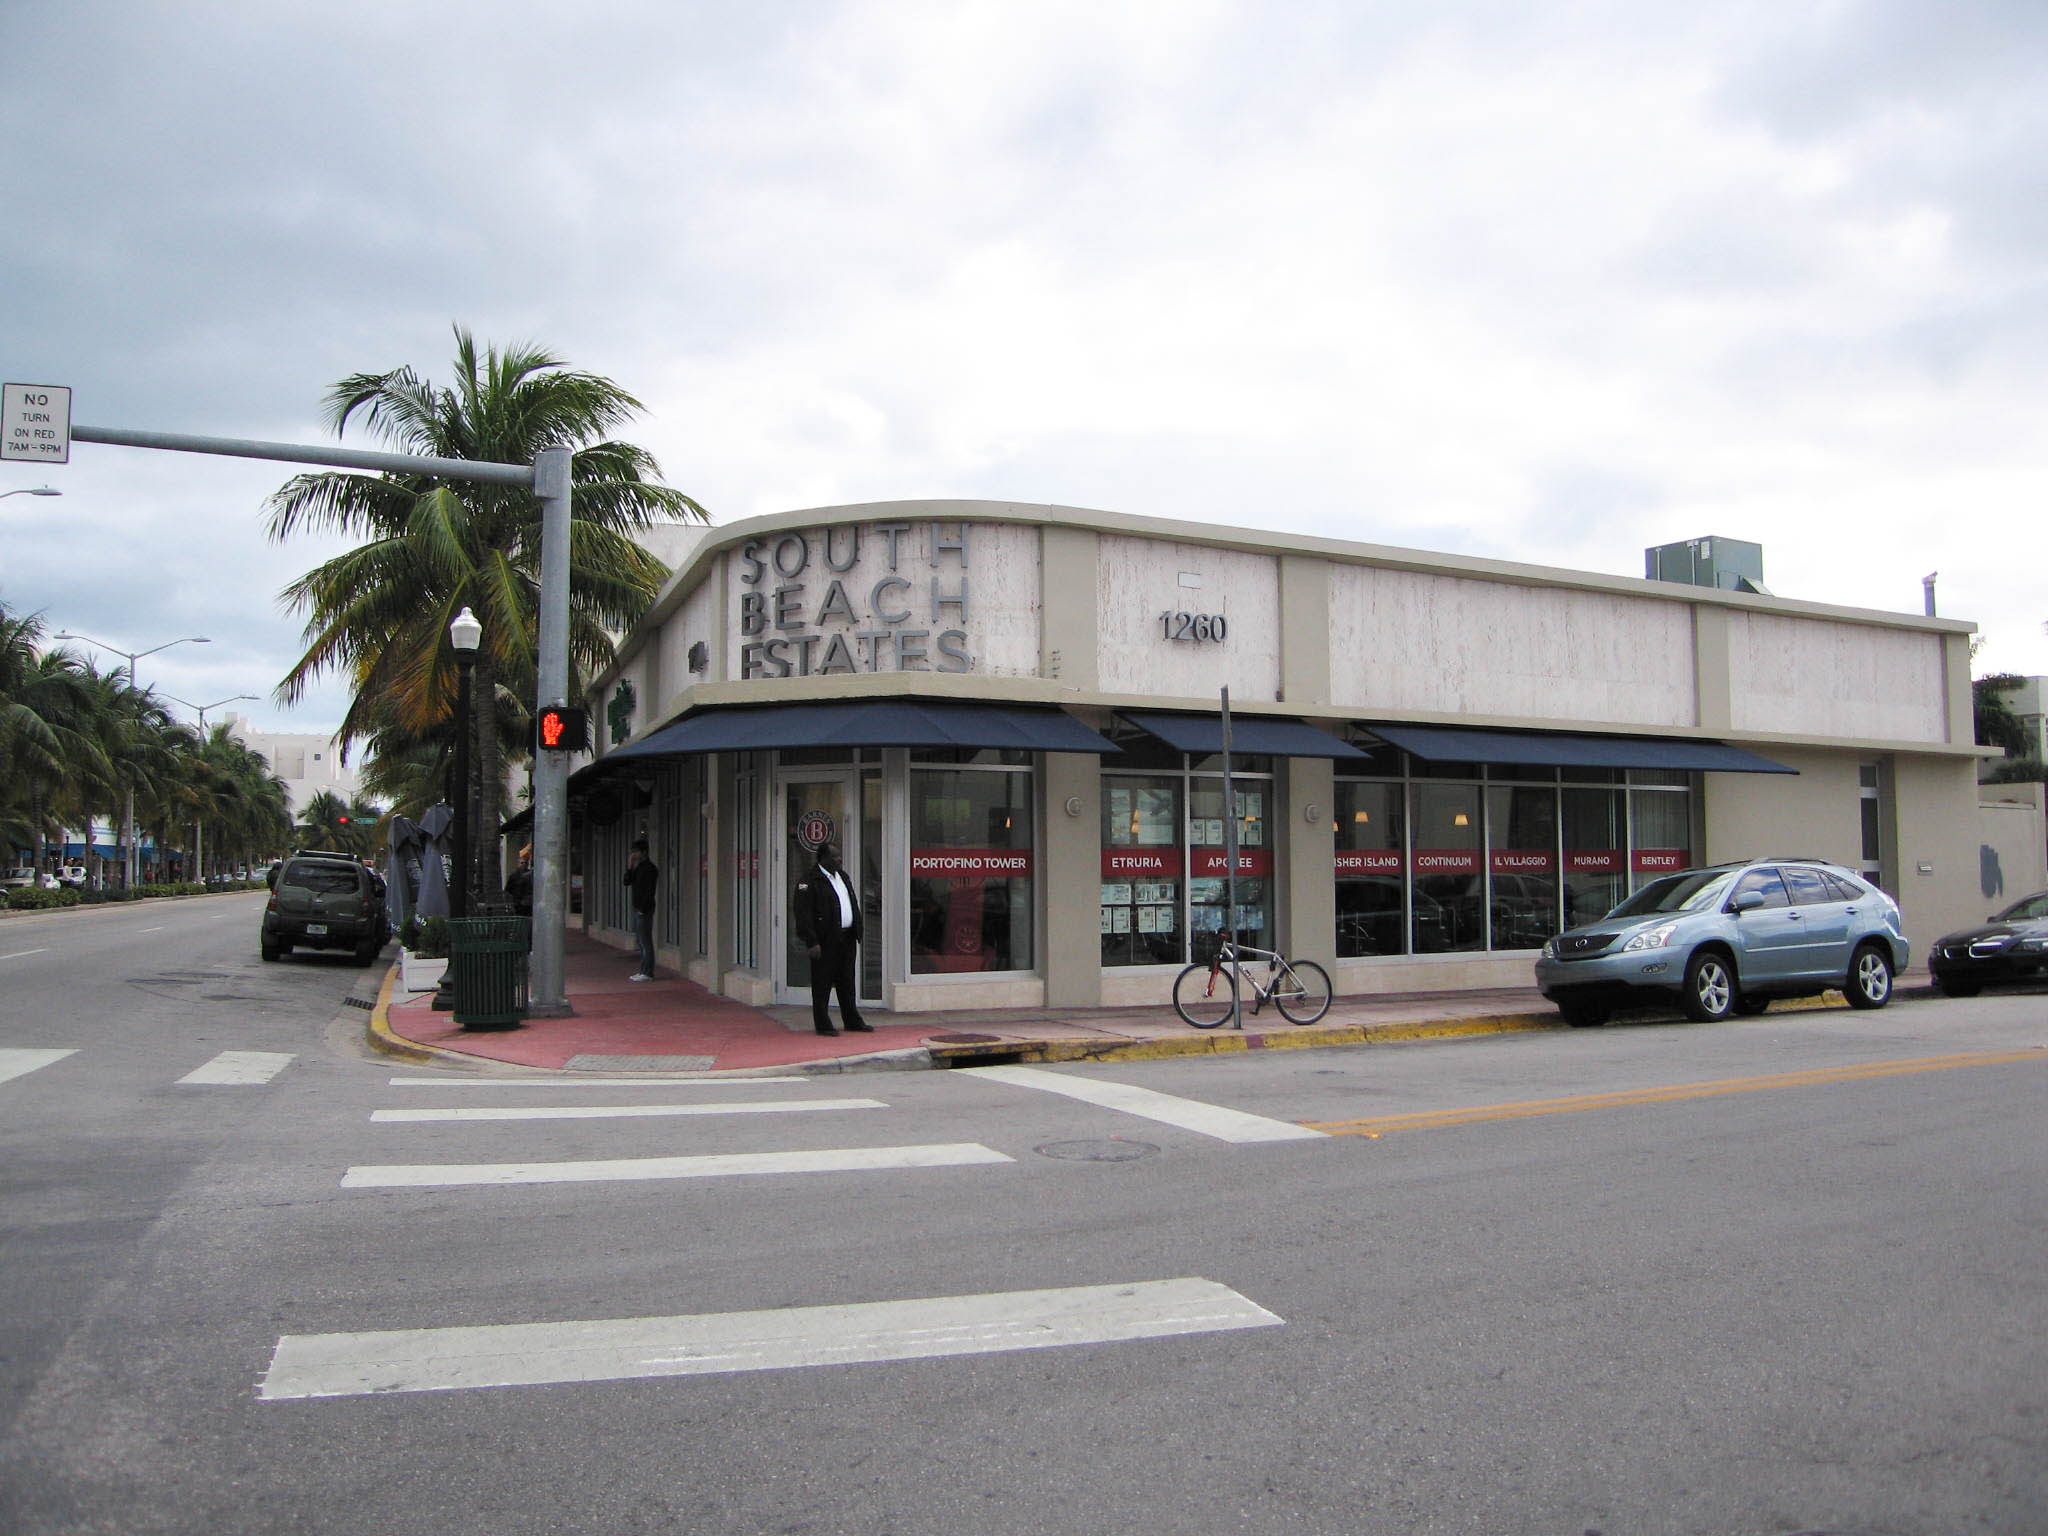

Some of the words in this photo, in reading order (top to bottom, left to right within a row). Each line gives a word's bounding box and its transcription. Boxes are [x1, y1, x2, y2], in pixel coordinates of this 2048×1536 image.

[24, 393, 48, 406] NO
[22, 412, 50, 423] TURN
[14, 428, 29, 437] ON
[34, 429, 55, 439] RED
[741, 523, 969, 585] SOUTH
[741, 576, 969, 636] BEACH
[1158, 610, 1228, 643] 1260
[741, 629, 971, 680] ESTATES
[913, 858, 982, 868] PORTOFINO
[984, 858, 1026, 868] TOWER
[1111, 857, 1162, 868] ETRURIA
[1364, 857, 1398, 867] ISLAND
[1418, 857, 1472, 866] CONTINUUM
[1495, 857, 1502, 866] IL
[1503, 857, 1547, 866] VILLAGGIO
[1574, 856, 1610, 865] MURANO
[1641, 856, 1676, 865] BENTLEY
